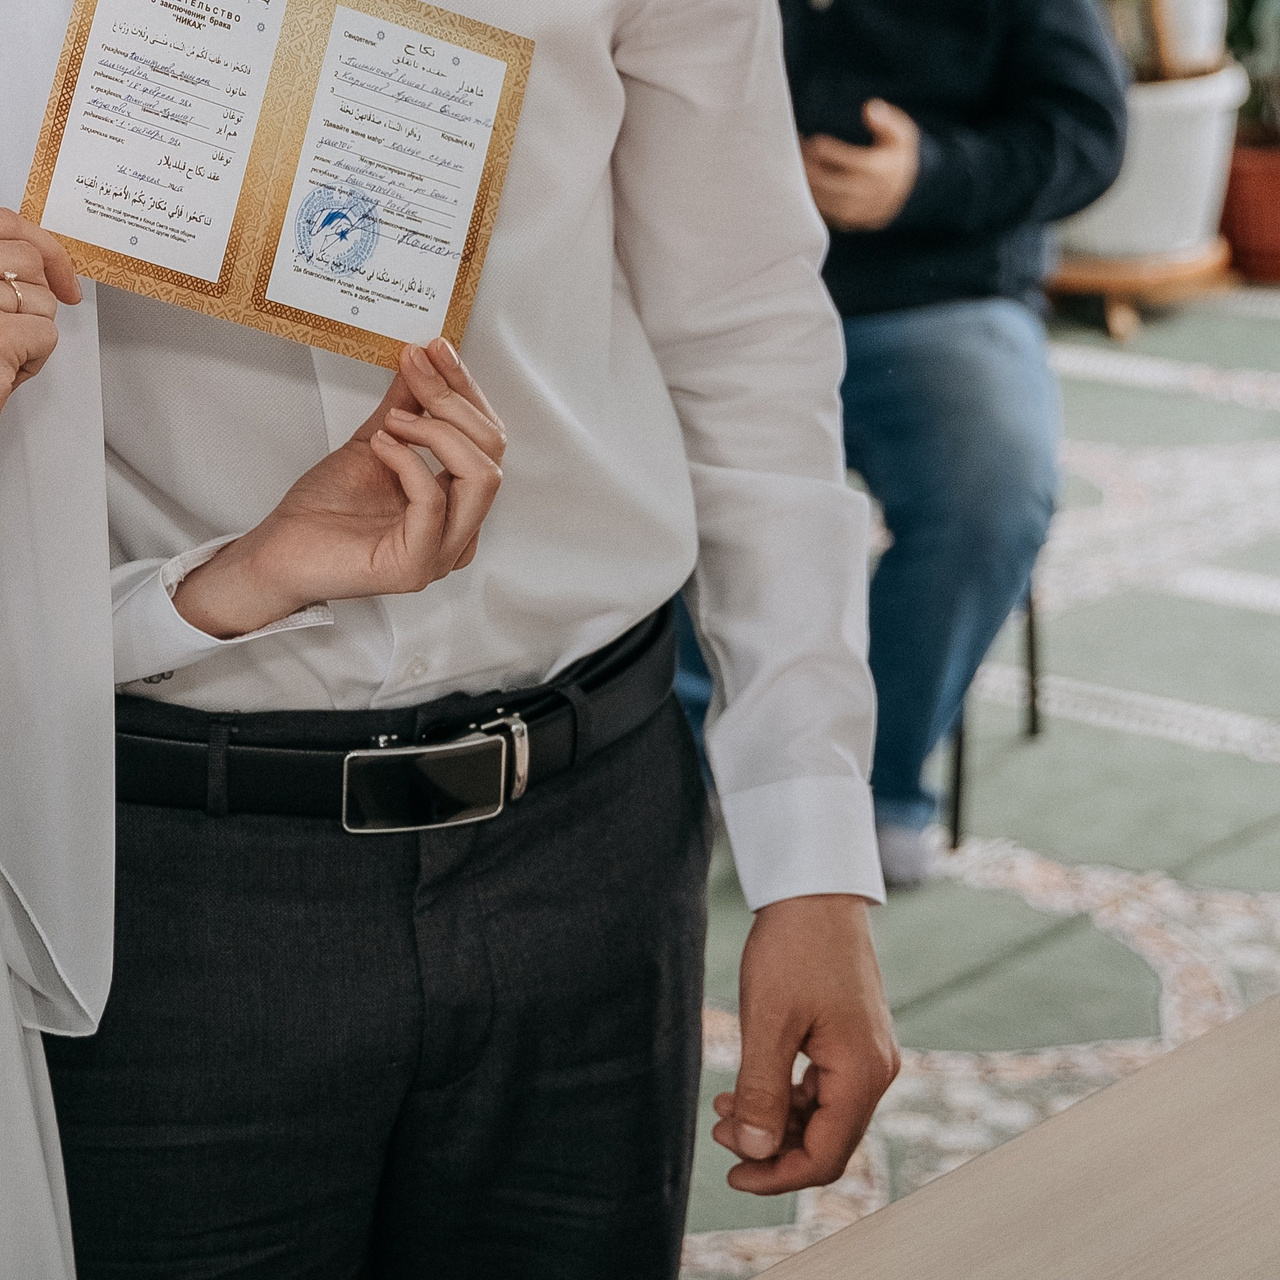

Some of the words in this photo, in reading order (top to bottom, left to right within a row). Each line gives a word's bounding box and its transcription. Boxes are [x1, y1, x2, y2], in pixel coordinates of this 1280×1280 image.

[159, 0, 206, 21] заключении
[209, 16, 231, 30] брака
[172, 13, 207, 30] "НИКАХ"
[344, 31, 377, 47] Свидетели:
